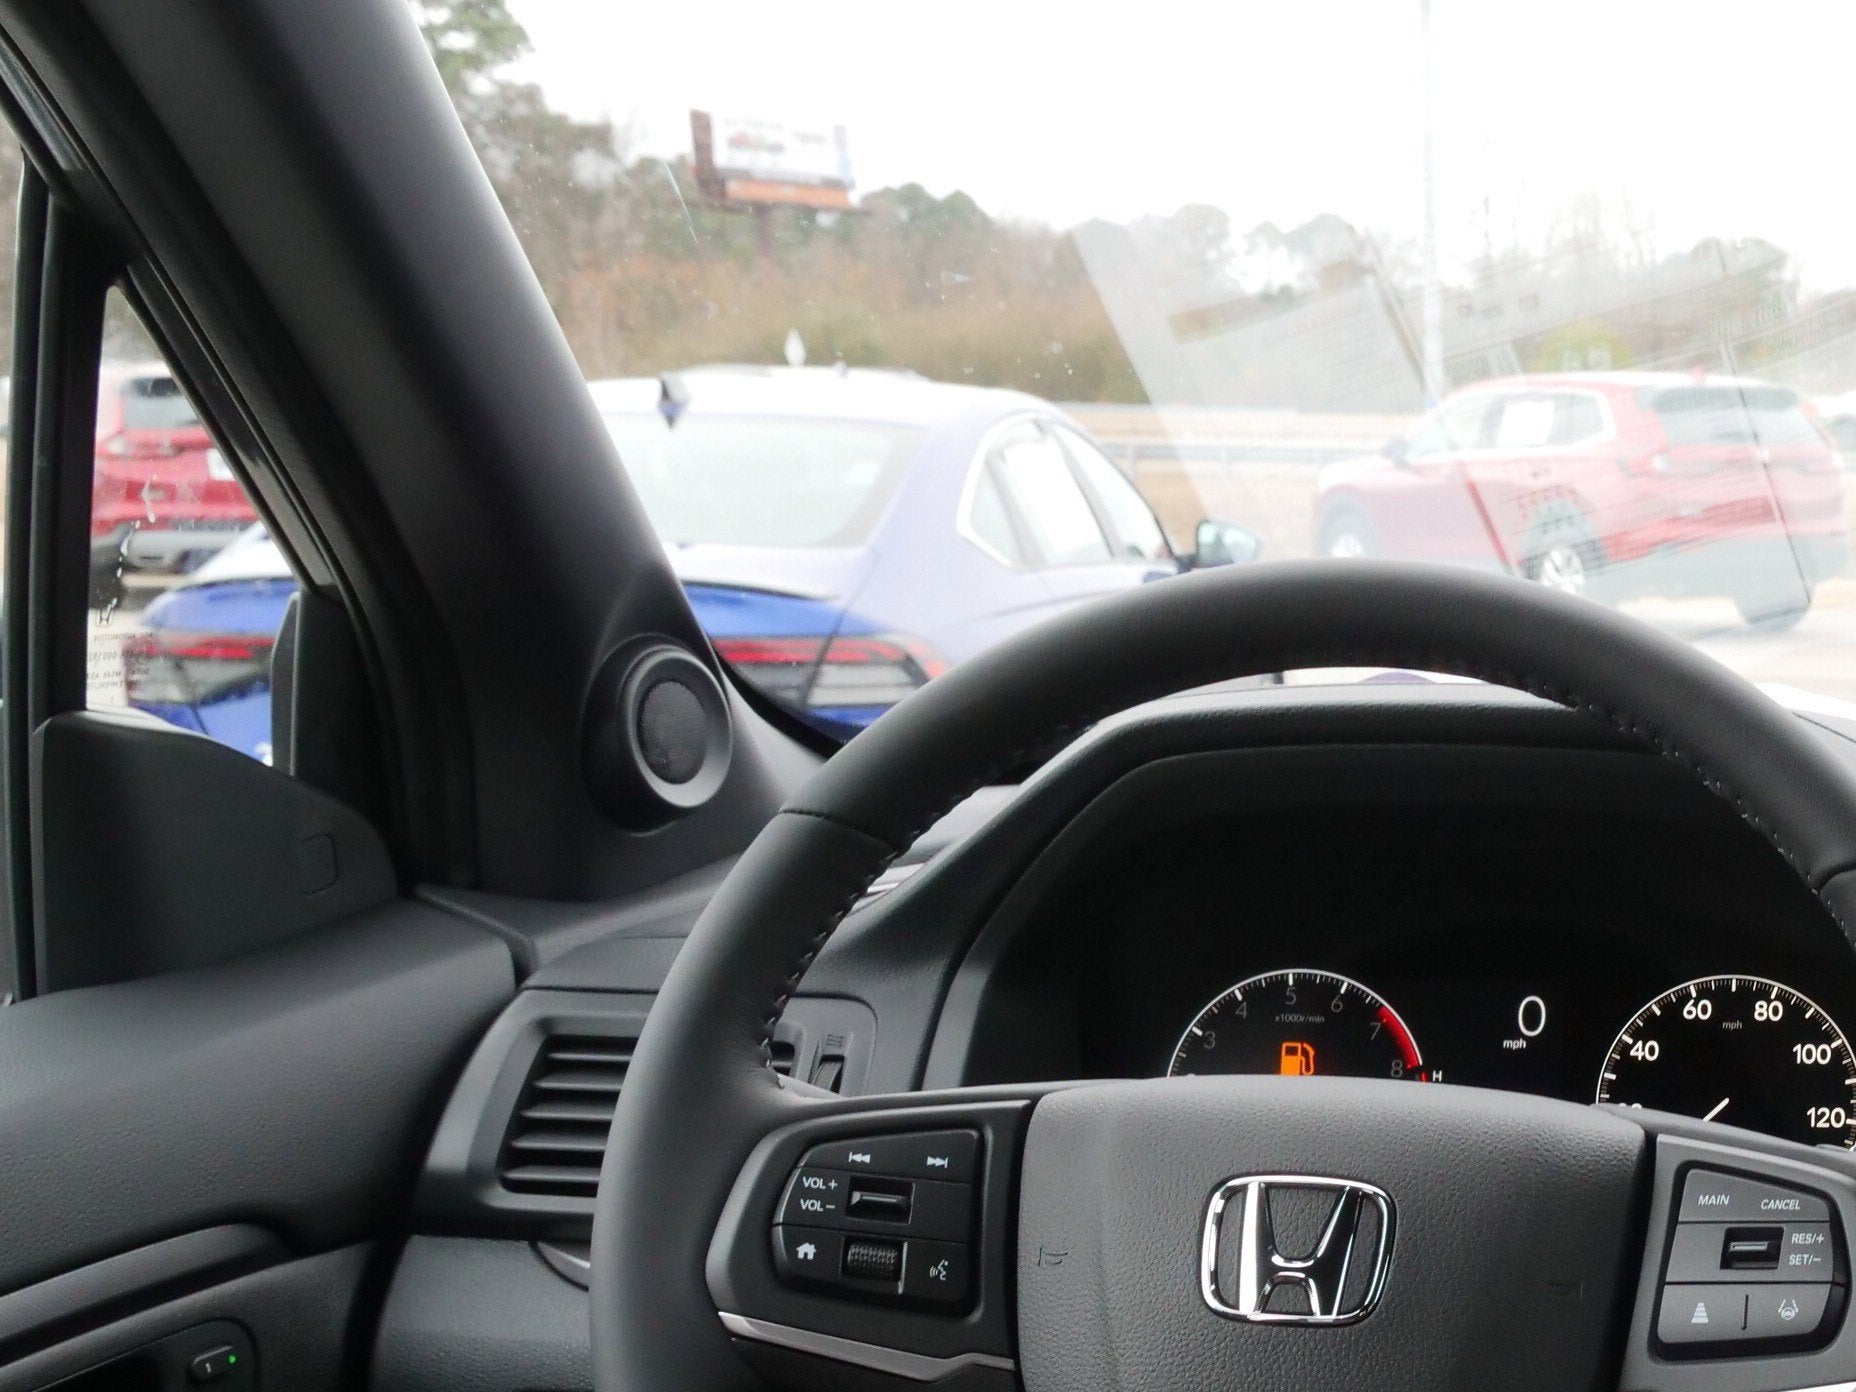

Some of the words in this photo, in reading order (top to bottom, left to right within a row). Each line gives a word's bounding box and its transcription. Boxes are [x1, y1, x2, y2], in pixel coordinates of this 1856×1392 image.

[1286, 988, 1297, 1005] 5
[1331, 995, 1343, 1013] 6
[1235, 1002, 1248, 1019] 4
[1518, 995, 1546, 1037] 0
[1683, 999, 1712, 1021] 60
[1753, 1000, 1784, 1022] 80
[1370, 1022, 1382, 1041] 7
[1722, 1020, 1742, 1032] mph
[1204, 1031, 1216, 1049] 3
[1503, 1038, 1526, 1051] mph
[1630, 1040, 1660, 1062] 40
[1792, 1043, 1832, 1065] 100
[1433, 1071, 1442, 1082] H
[1806, 1107, 1846, 1129] 120
[803, 1176, 826, 1189] VOL
[800, 1199, 823, 1212] VOL
[1698, 1195, 1730, 1206] MAIN
[1760, 1199, 1801, 1211] CANCEL
